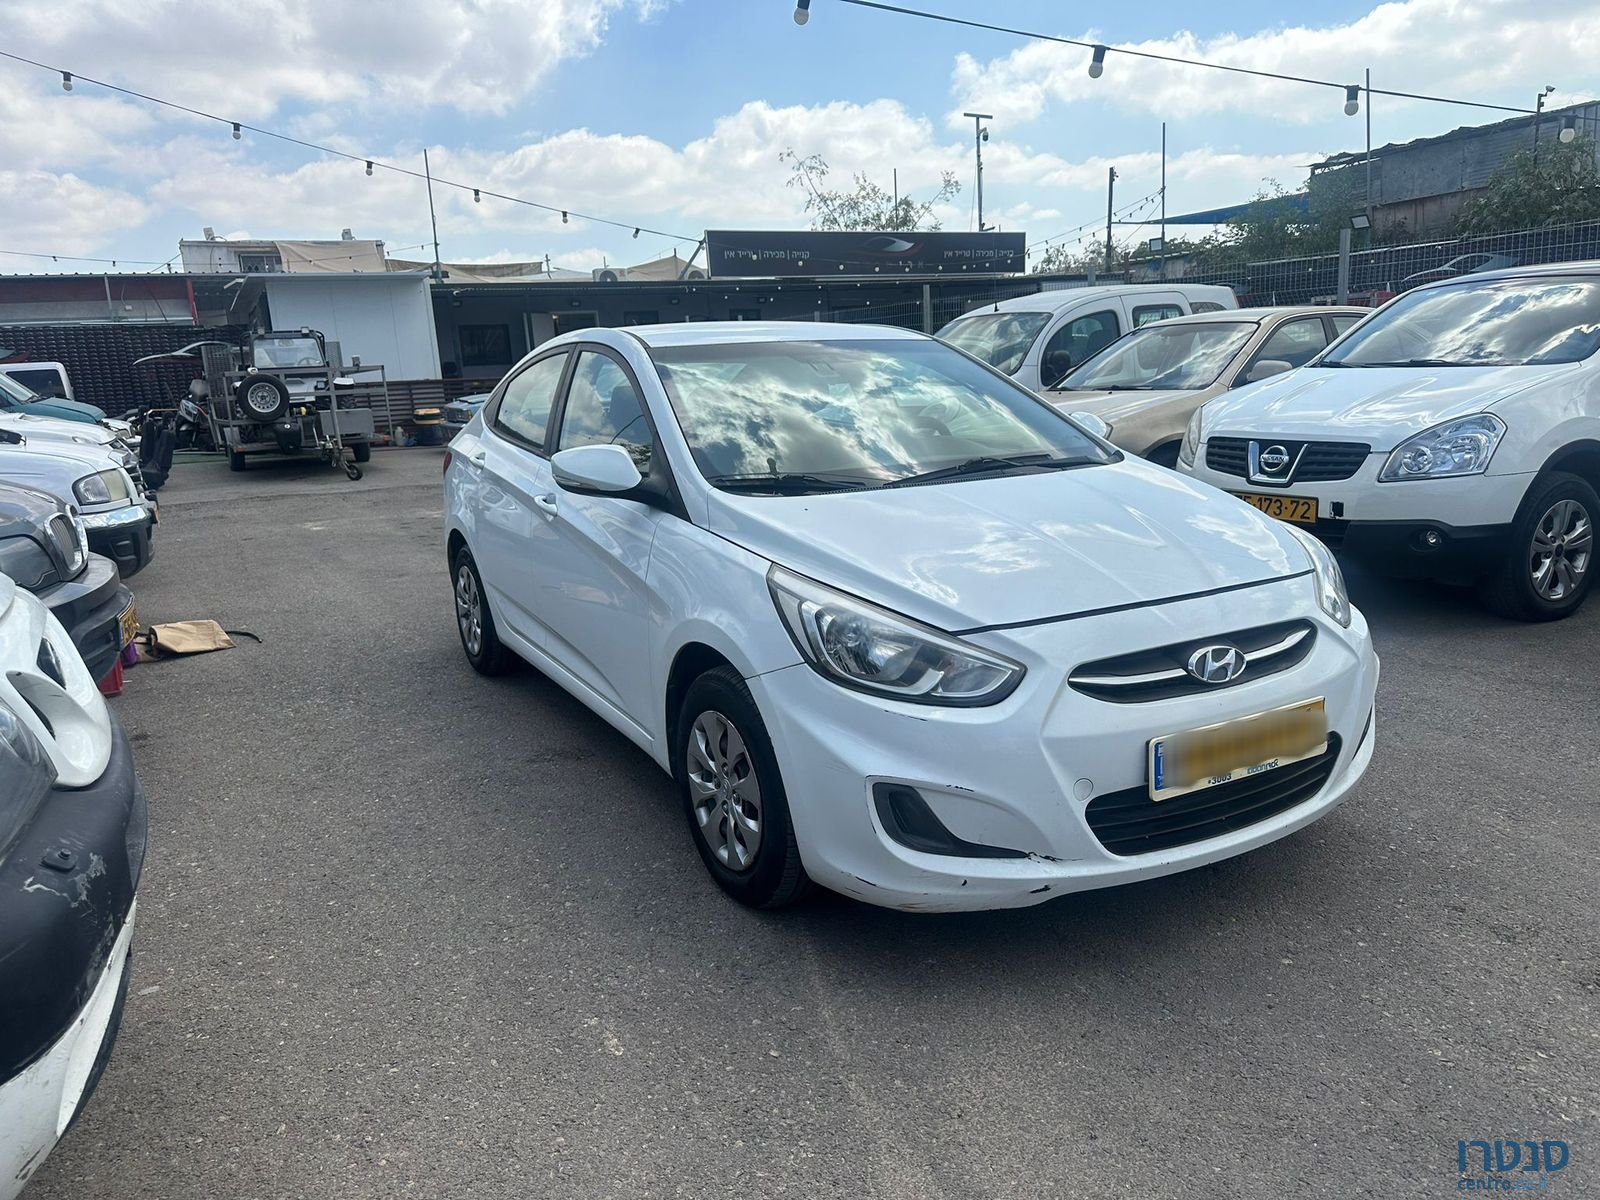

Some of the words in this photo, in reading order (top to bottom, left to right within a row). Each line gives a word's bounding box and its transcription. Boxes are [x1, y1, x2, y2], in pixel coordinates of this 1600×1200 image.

[724, 250, 735, 260] אין
[764, 251, 785, 259] מכירה
[954, 250, 971, 259] טרייד
[975, 250, 994, 259] מכירה
